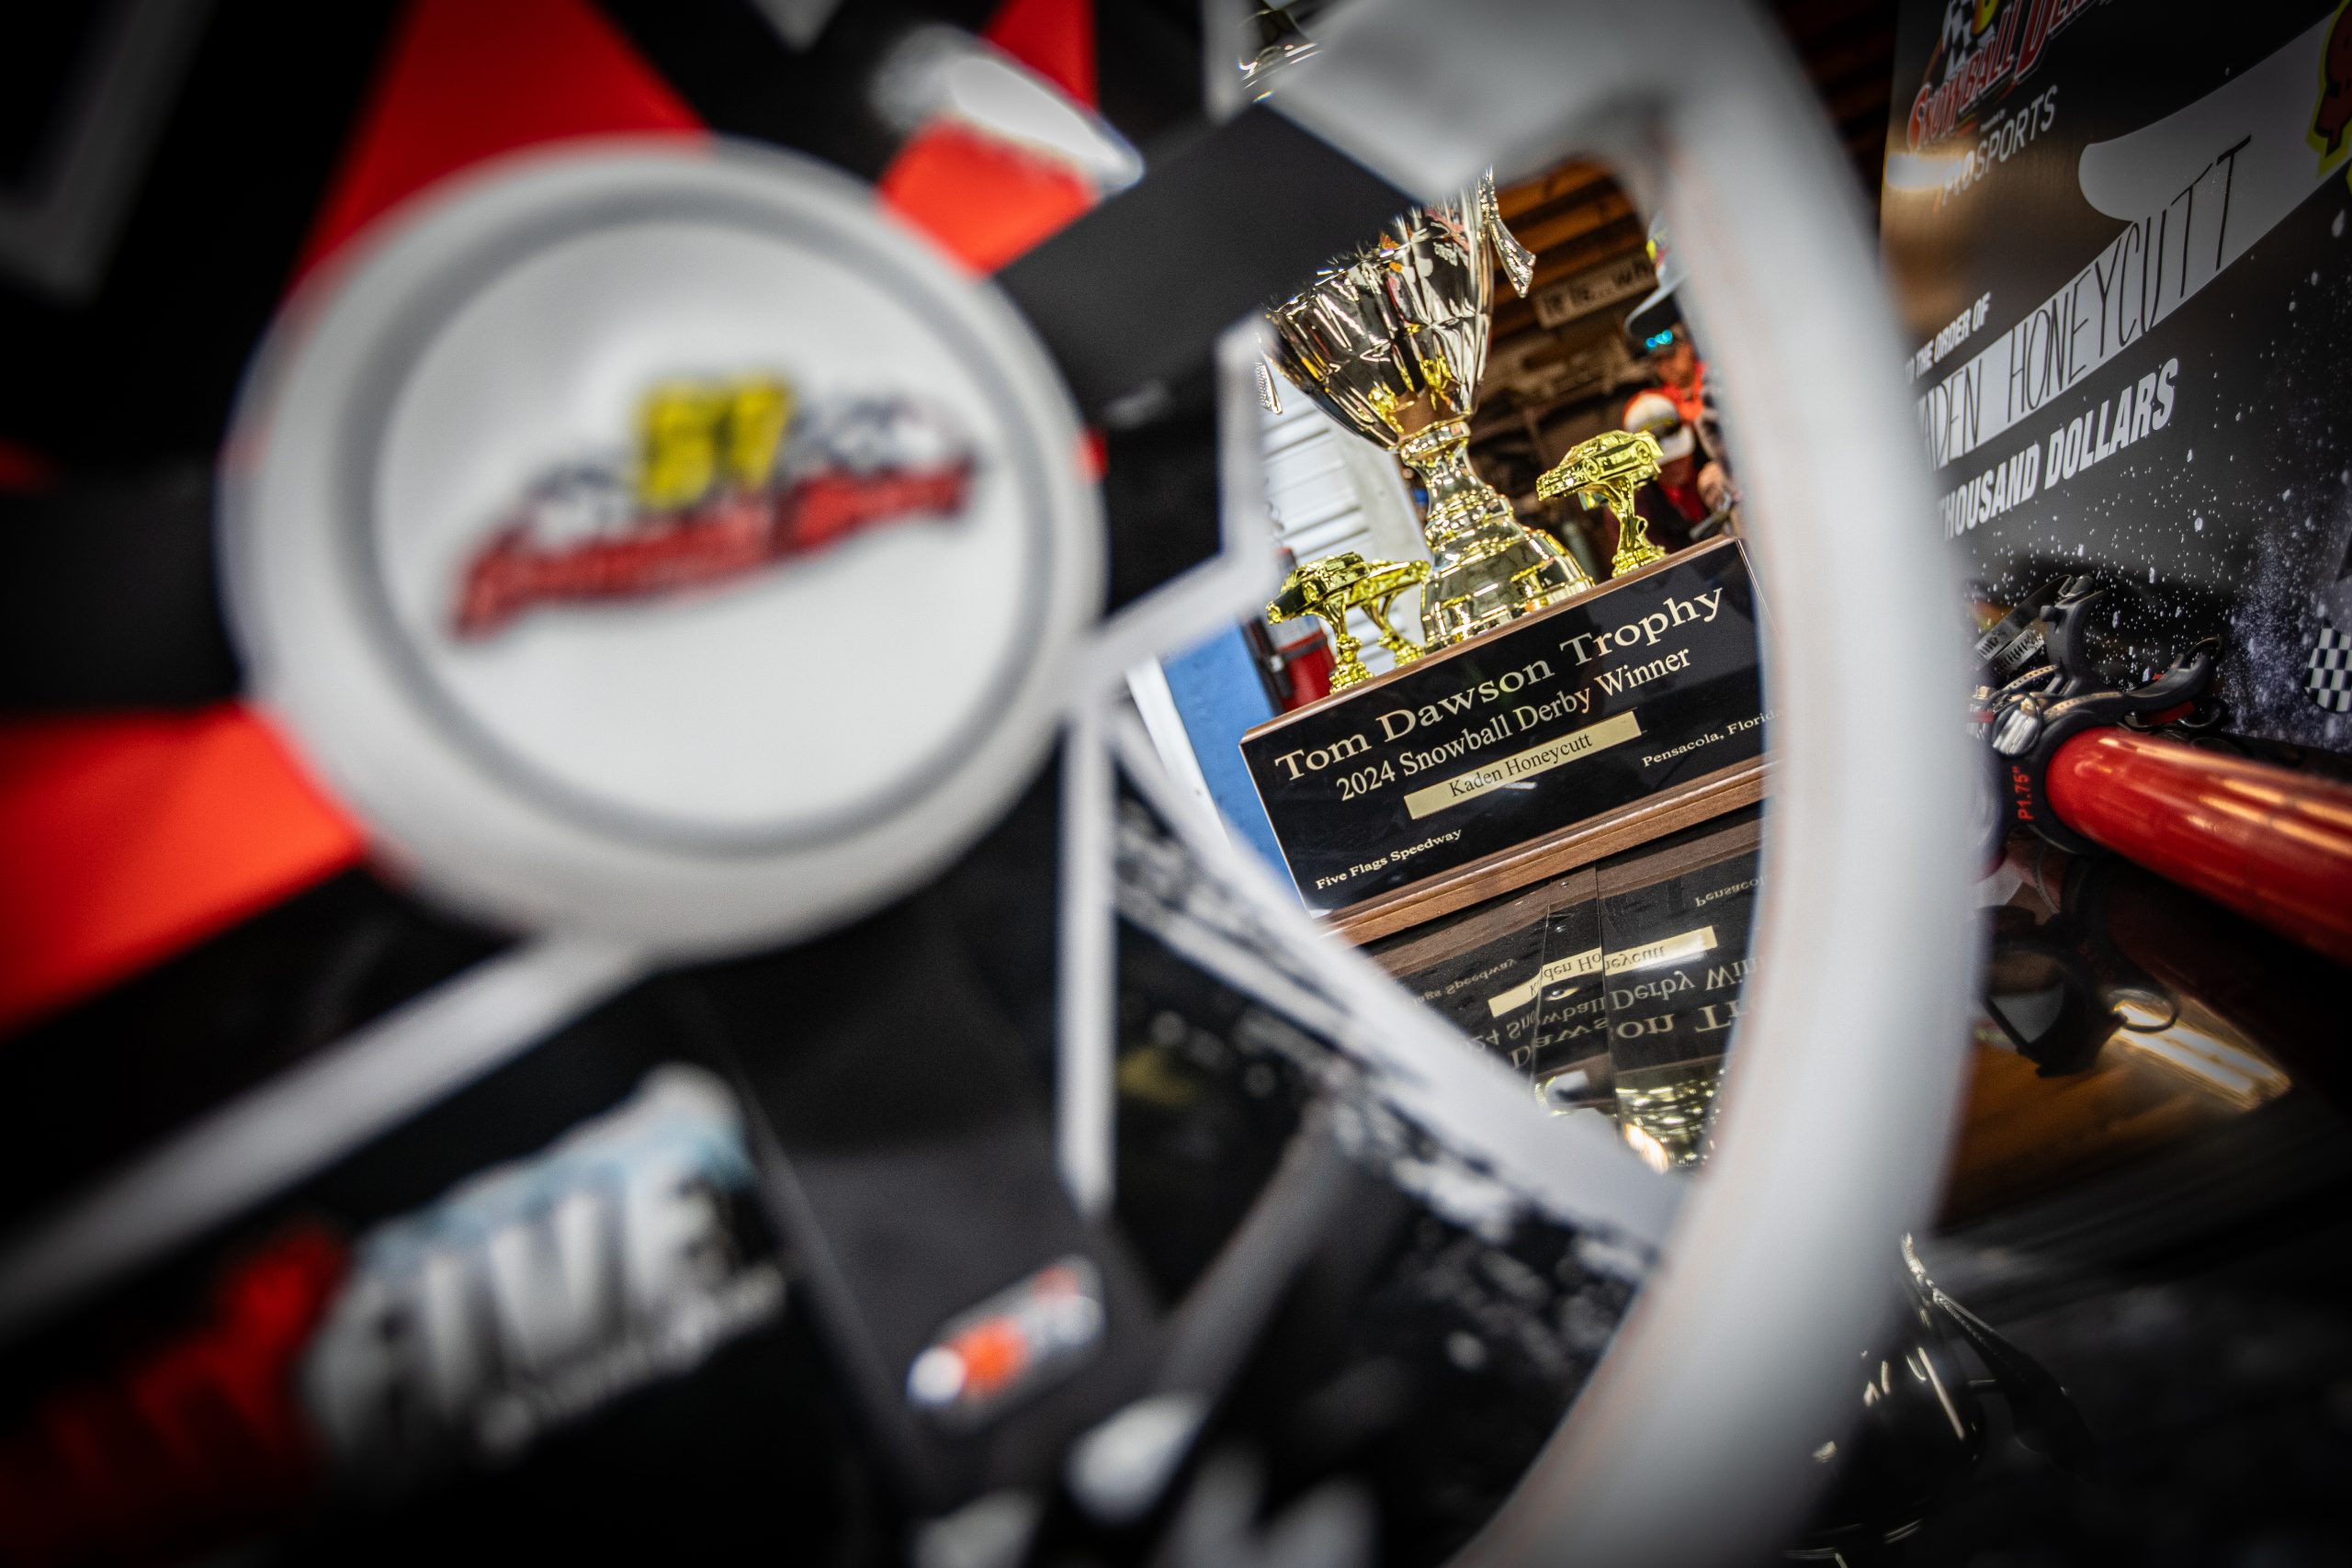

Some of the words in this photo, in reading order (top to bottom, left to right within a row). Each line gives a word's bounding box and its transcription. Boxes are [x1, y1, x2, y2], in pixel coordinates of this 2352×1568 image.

[1916, 338, 1935, 380] THE
[1933, 308, 1972, 364] ORDER
[1972, 291, 1992, 333] OF
[1918, 357, 1983, 471] ADEN
[2007, 134, 2252, 424] HONEYCUTT
[2044, 358, 2178, 491] DOLLARS
[1274, 735, 1372, 781] Tom
[1375, 660, 1555, 743] Dawson
[1559, 586, 1724, 666] Trophy
[1336, 760, 1396, 802] 2024
[1401, 716, 1511, 776] Snowball
[1517, 684, 1589, 732] Derby
[1594, 649, 1690, 697] Winner
[1642, 733, 1724, 767] Pensacola,
[1726, 710, 1781, 735] Florid
[1449, 765, 1502, 797] Kaden
[1505, 733, 1592, 776] Honeycutt
[1316, 870, 1348, 890] Five
[1351, 855, 1388, 877] Flags
[1390, 829, 1462, 865] Speedway
